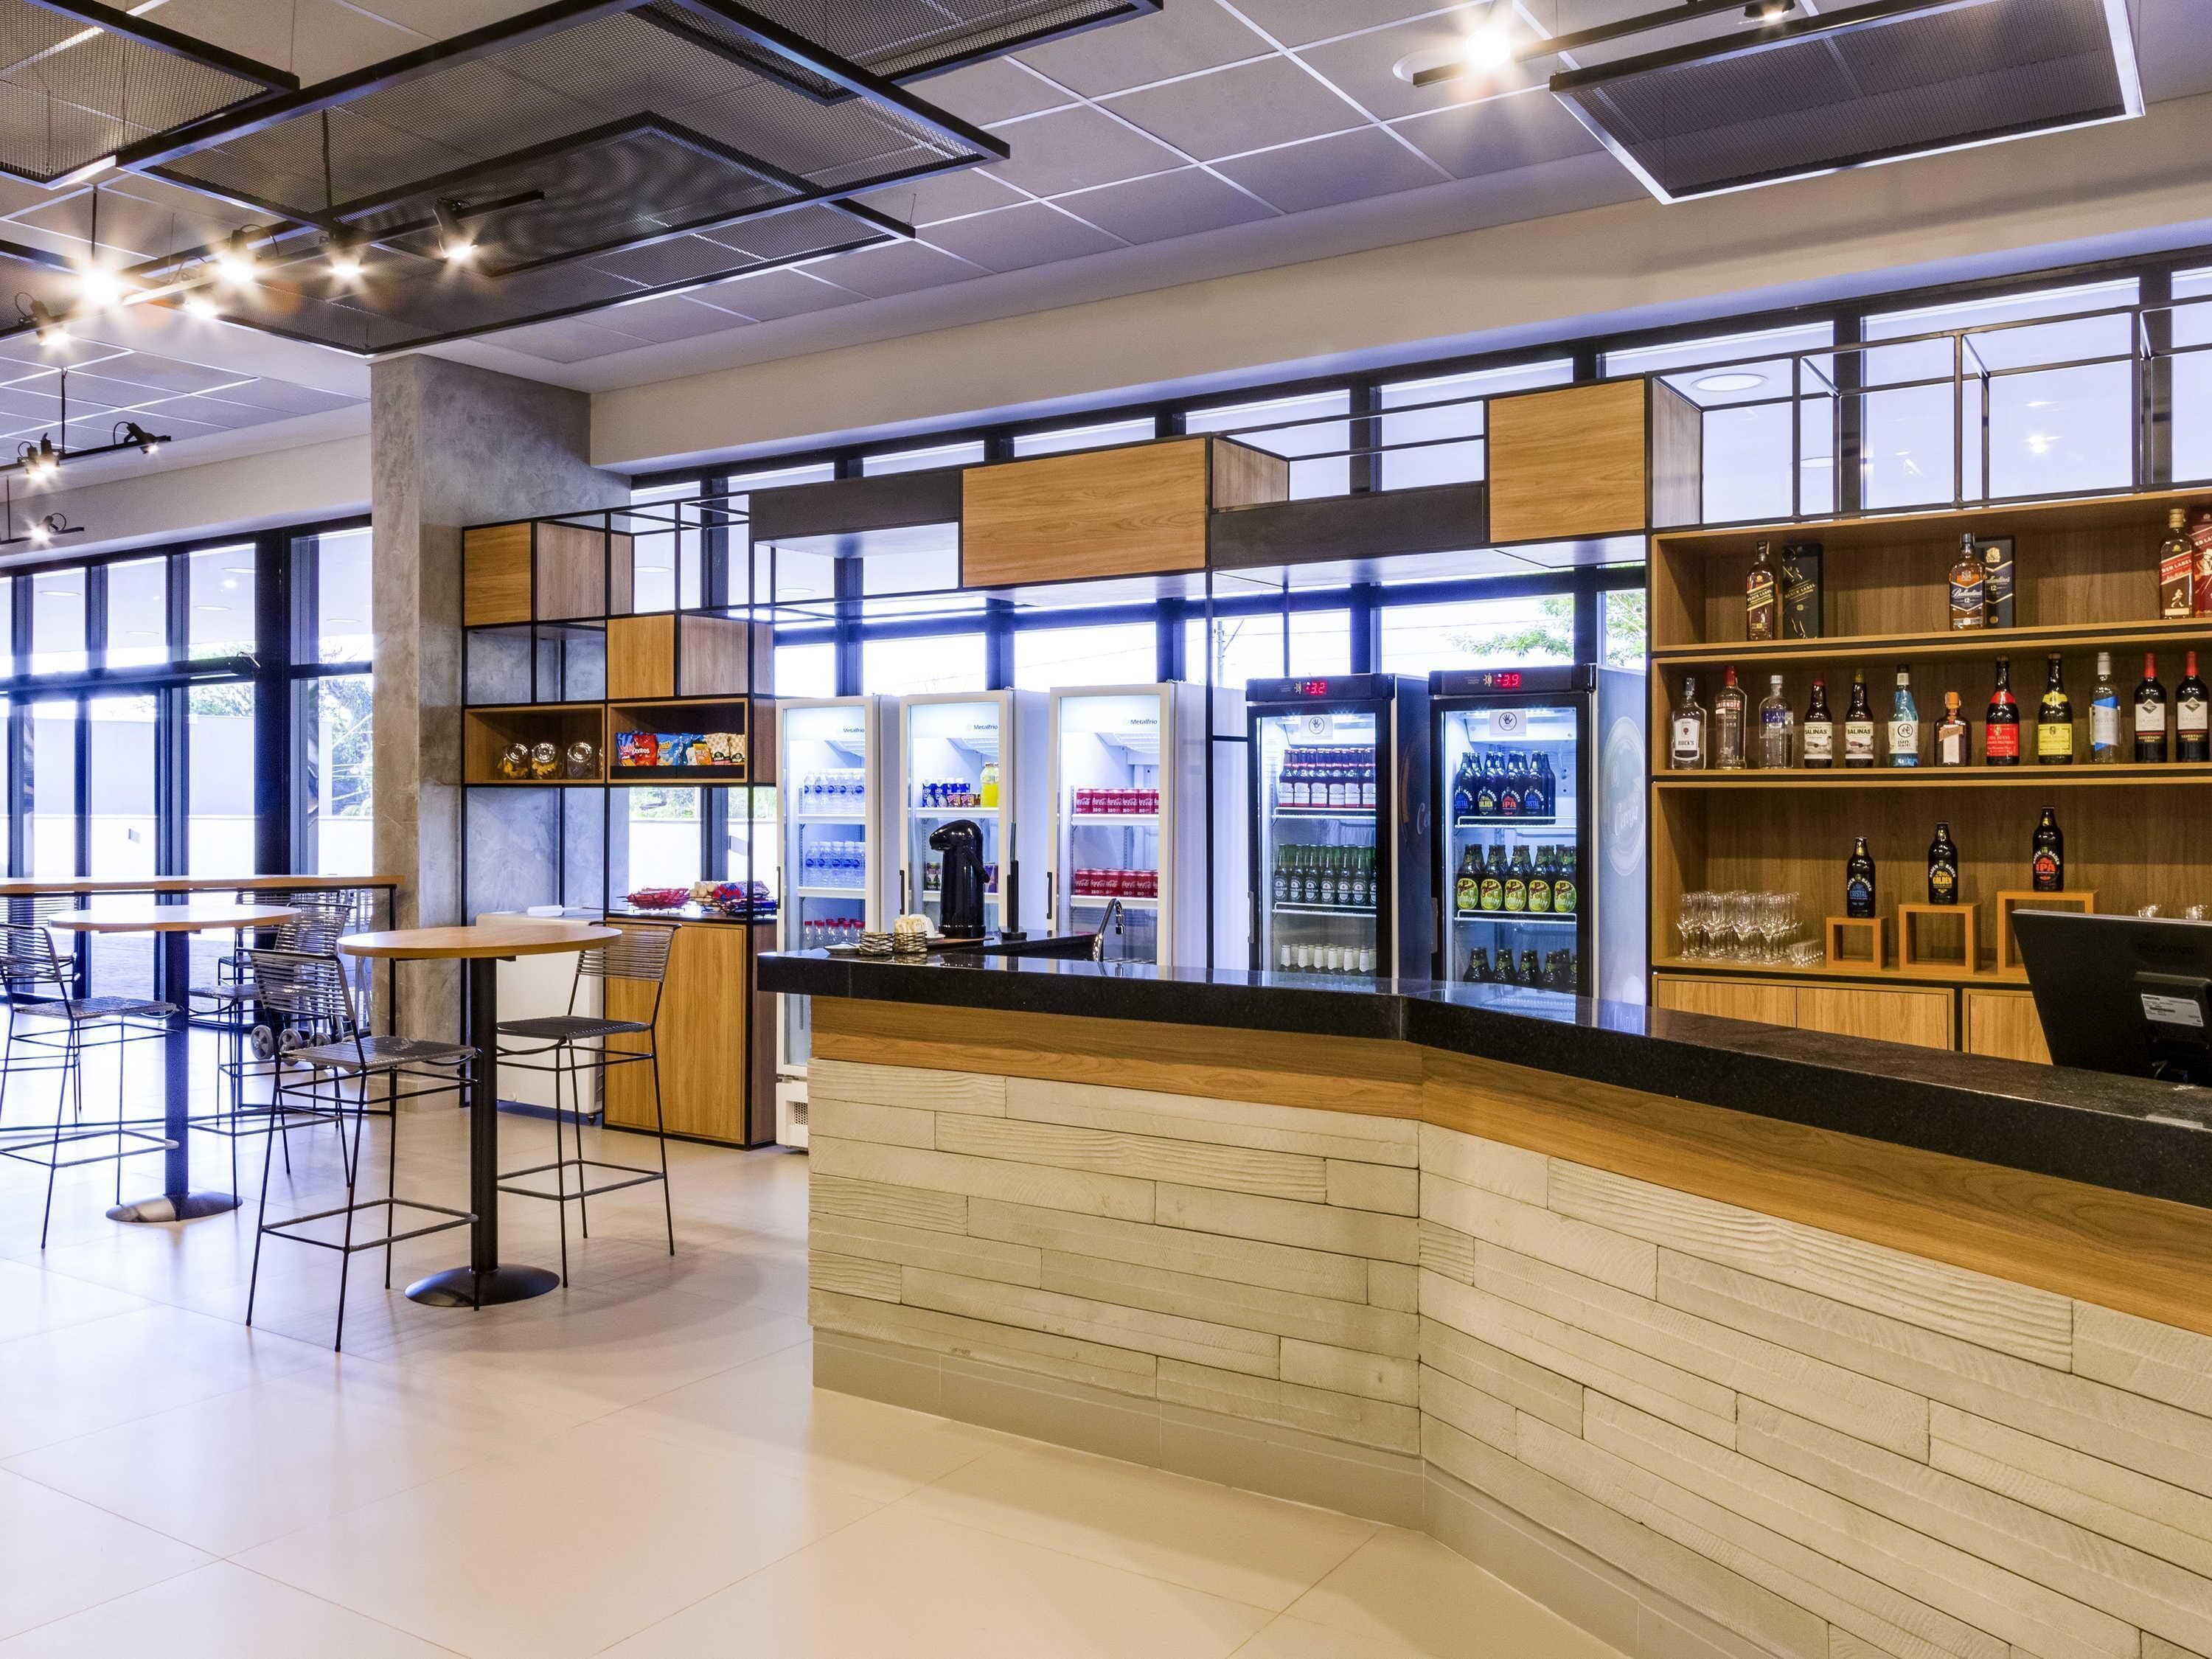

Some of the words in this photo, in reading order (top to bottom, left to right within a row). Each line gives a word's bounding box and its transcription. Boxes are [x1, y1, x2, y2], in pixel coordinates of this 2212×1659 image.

[2161, 565, 2174, 573] RED
[2174, 558, 2192, 568] LABEL
[1801, 583, 1815, 591] LABEL
[2036, 863, 2056, 872] IPA
